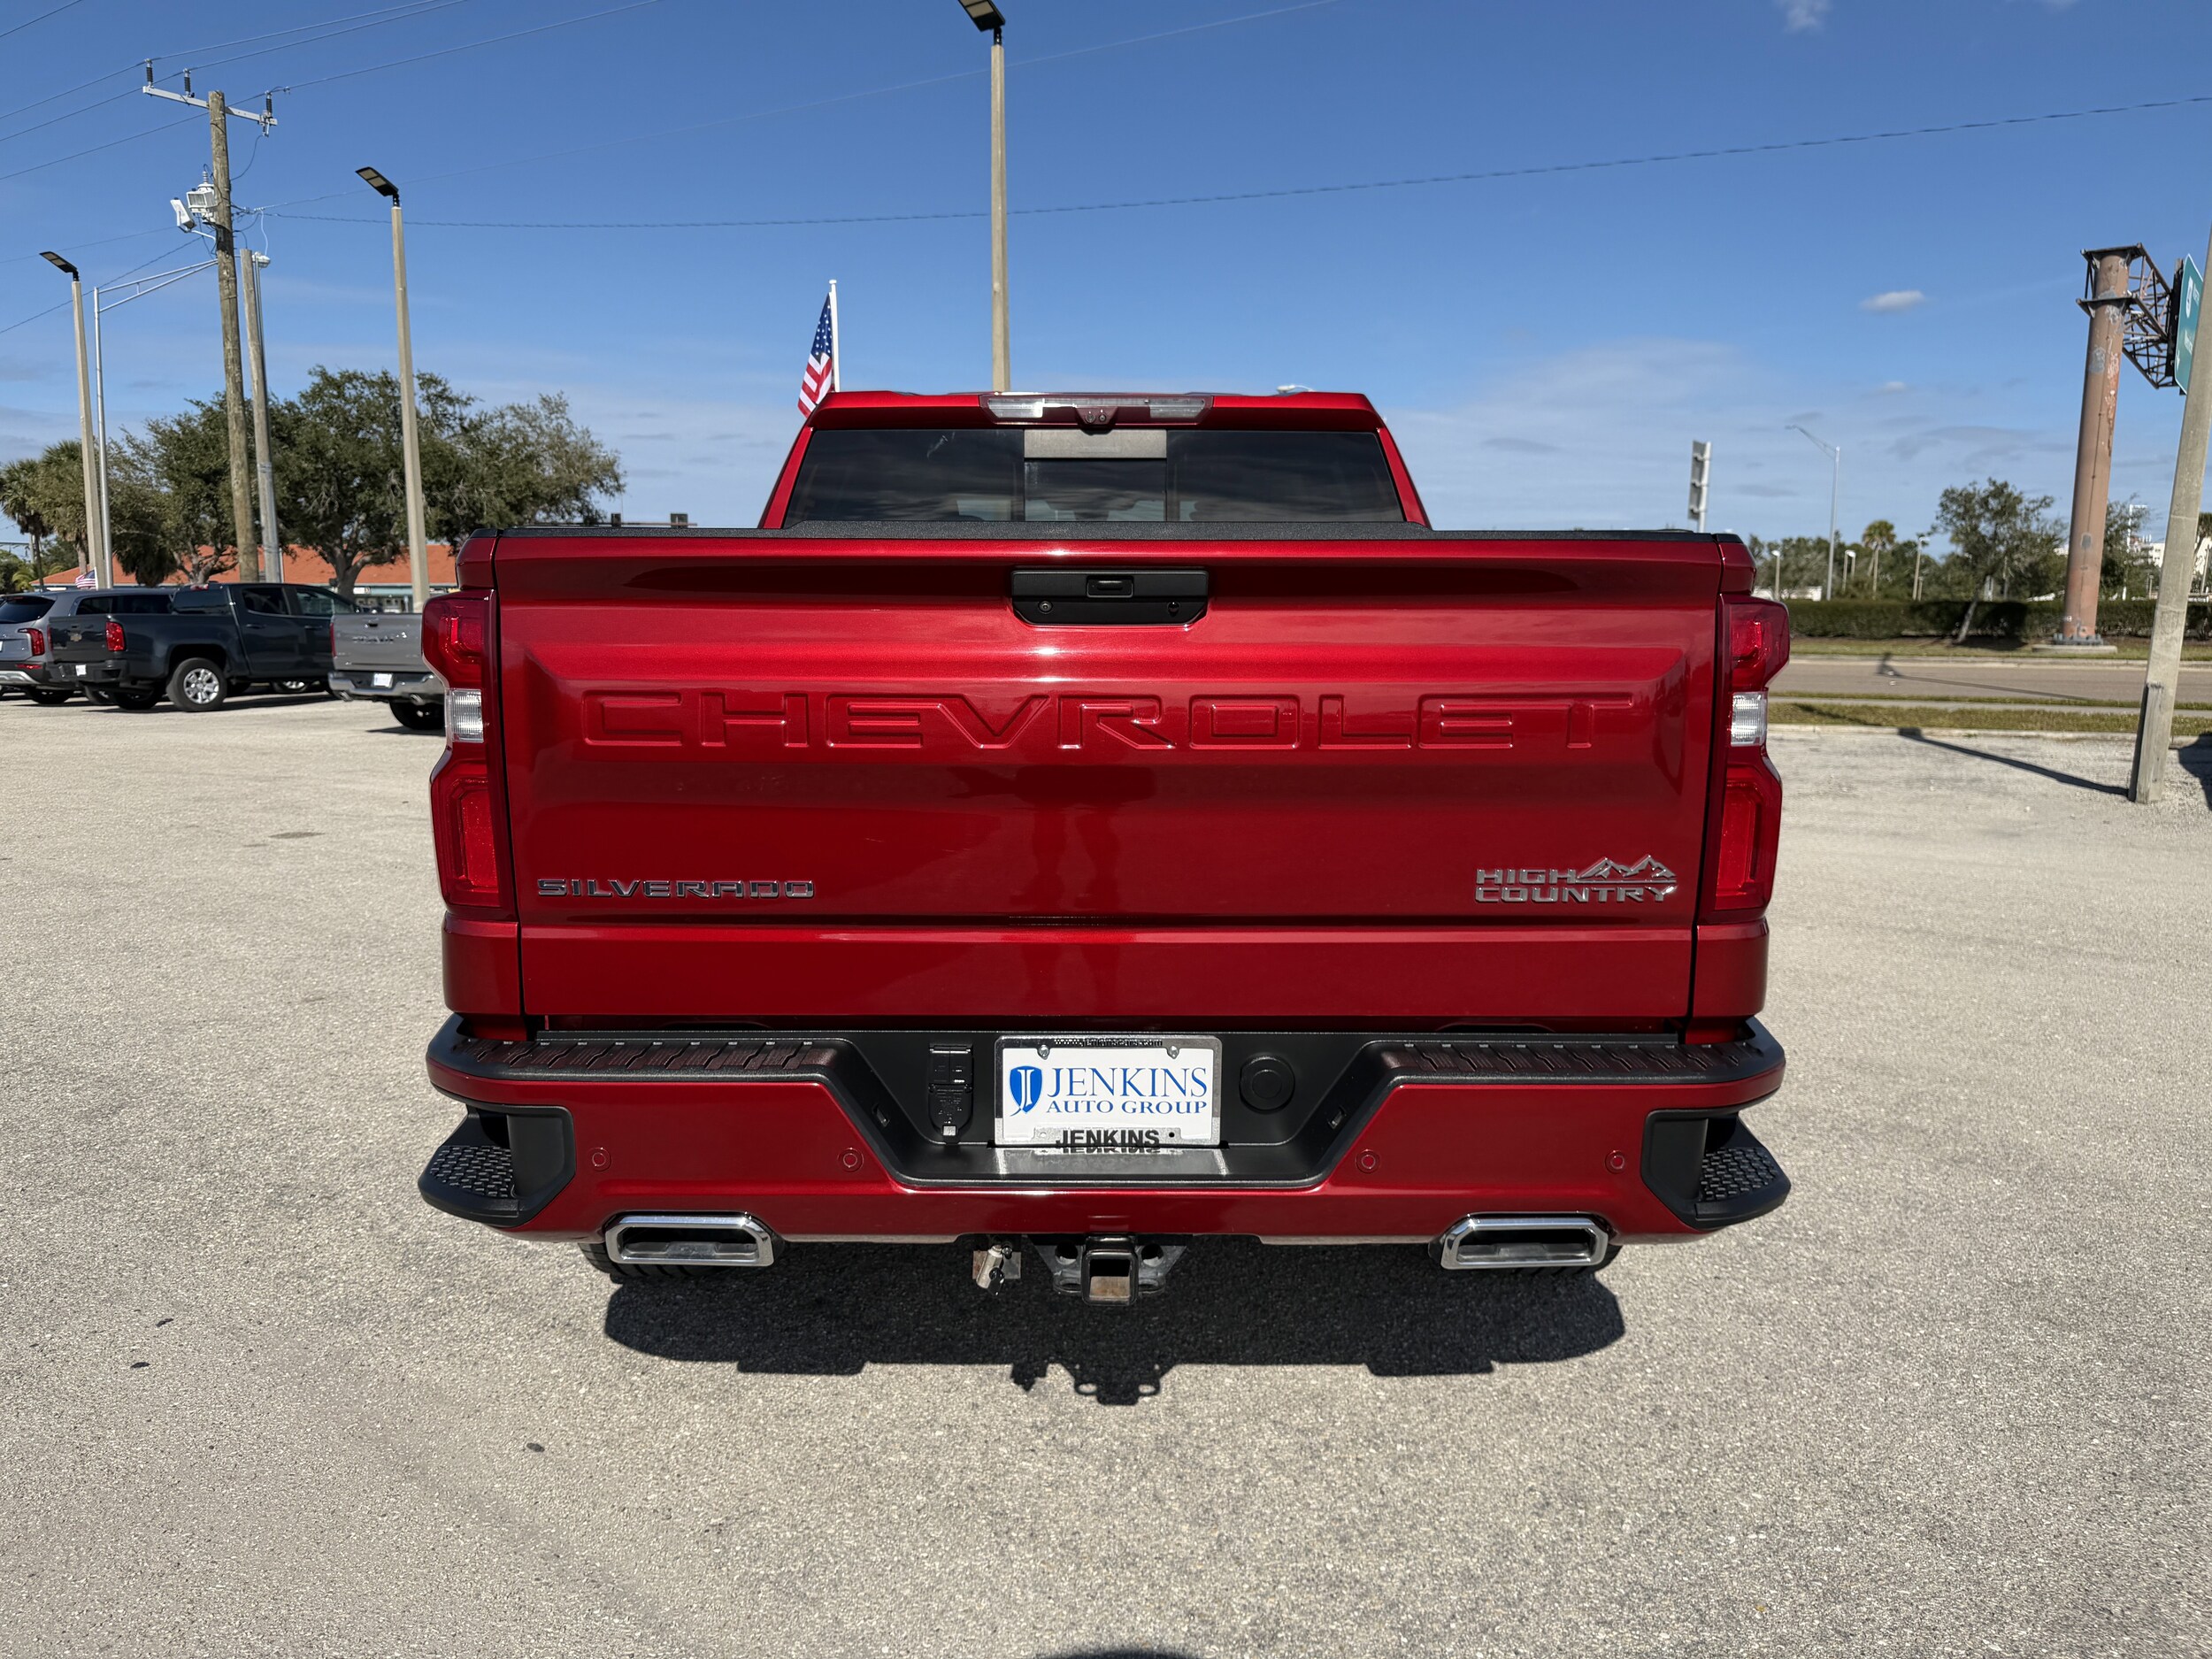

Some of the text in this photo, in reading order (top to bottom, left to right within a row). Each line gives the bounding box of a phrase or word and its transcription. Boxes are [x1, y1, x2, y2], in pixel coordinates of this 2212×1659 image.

[582, 691, 1633, 749] CHEVROLET
[1477, 868, 1576, 885] HIGH
[537, 879, 817, 898] SILVERADO
[1475, 886, 1678, 903] COUNTRY
[1047, 1067, 1208, 1098] JENKINS
[1046, 1100, 1208, 1115] AUTO GROUP
[1056, 1129, 1160, 1147] JENKINS
